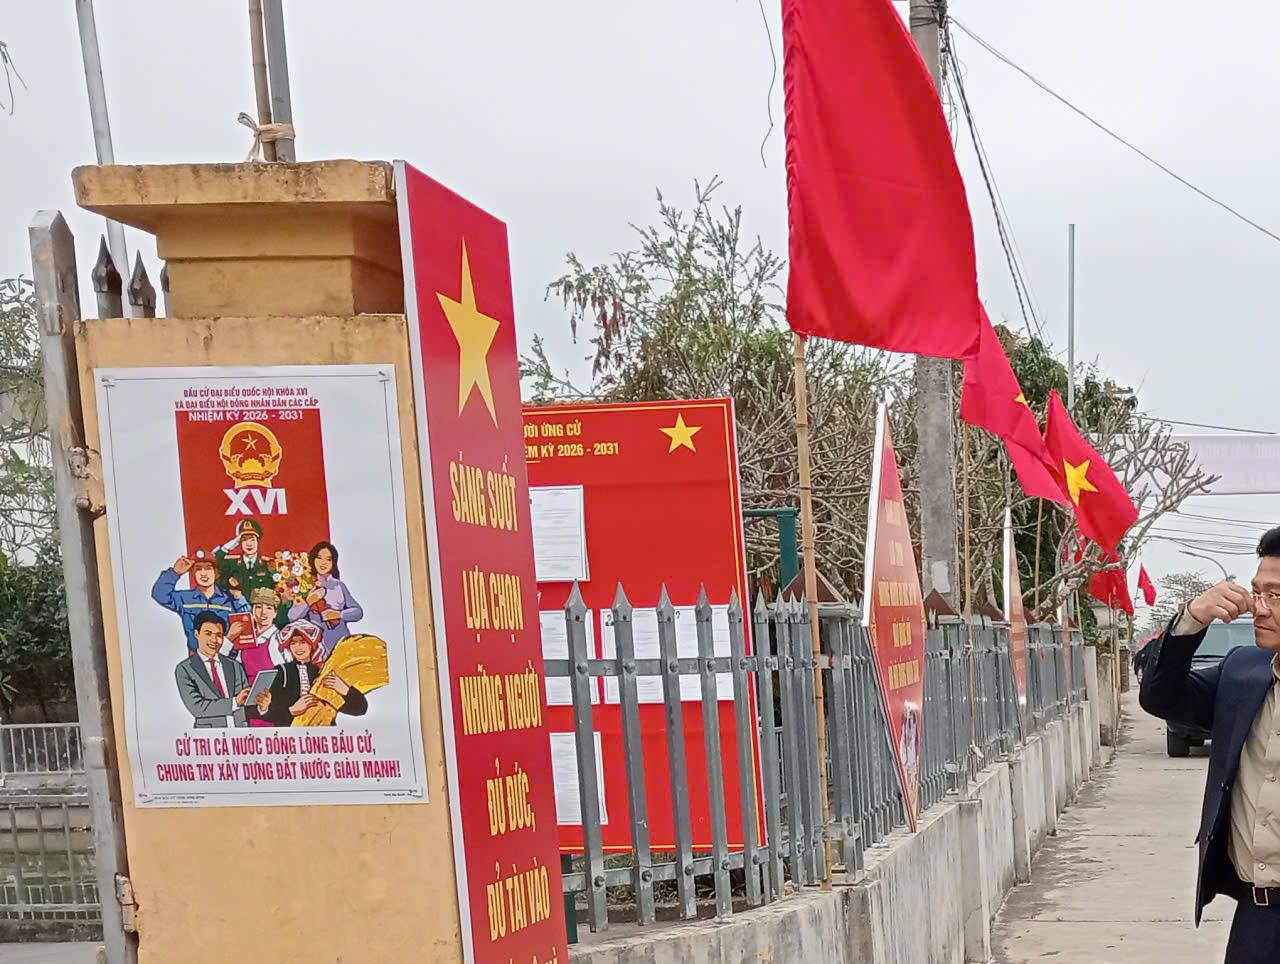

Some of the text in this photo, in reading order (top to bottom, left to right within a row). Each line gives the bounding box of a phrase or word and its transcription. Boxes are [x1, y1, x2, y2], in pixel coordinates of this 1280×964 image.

[189, 410, 223, 422] NHIỆM
[243, 411, 268, 420] 2026
[279, 410, 303, 420] 2031
[541, 421, 564, 437] ỨNG
[566, 419, 581, 436] CỬ
[558, 444, 584, 457] 2026
[593, 443, 619, 456] 2031
[223, 488, 288, 515] XVI
[450, 451, 518, 531] SÁNG SUỐT
[463, 565, 489, 643] LỰA
[490, 572, 524, 643] CHỌN
[460, 660, 542, 735] NHỮNG NGƯỜI
[175, 733, 191, 757] CỬ
[193, 738, 210, 756] TRI
[214, 732, 230, 756] CẢ
[232, 733, 263, 756] NƯỚC
[266, 731, 296, 755] ĐỒNG
[300, 732, 328, 755] LÒNG
[332, 731, 353, 754] BẦU
[156, 756, 401, 784] CHUNG TAY XÂY DỰNG ĐẤT NƯỚC GIÀU MẠNH!
[487, 757, 506, 836] ĐỦ
[505, 761, 536, 832] ĐỨC,
[487, 857, 550, 941] ĐỦ TÀI VÀO
